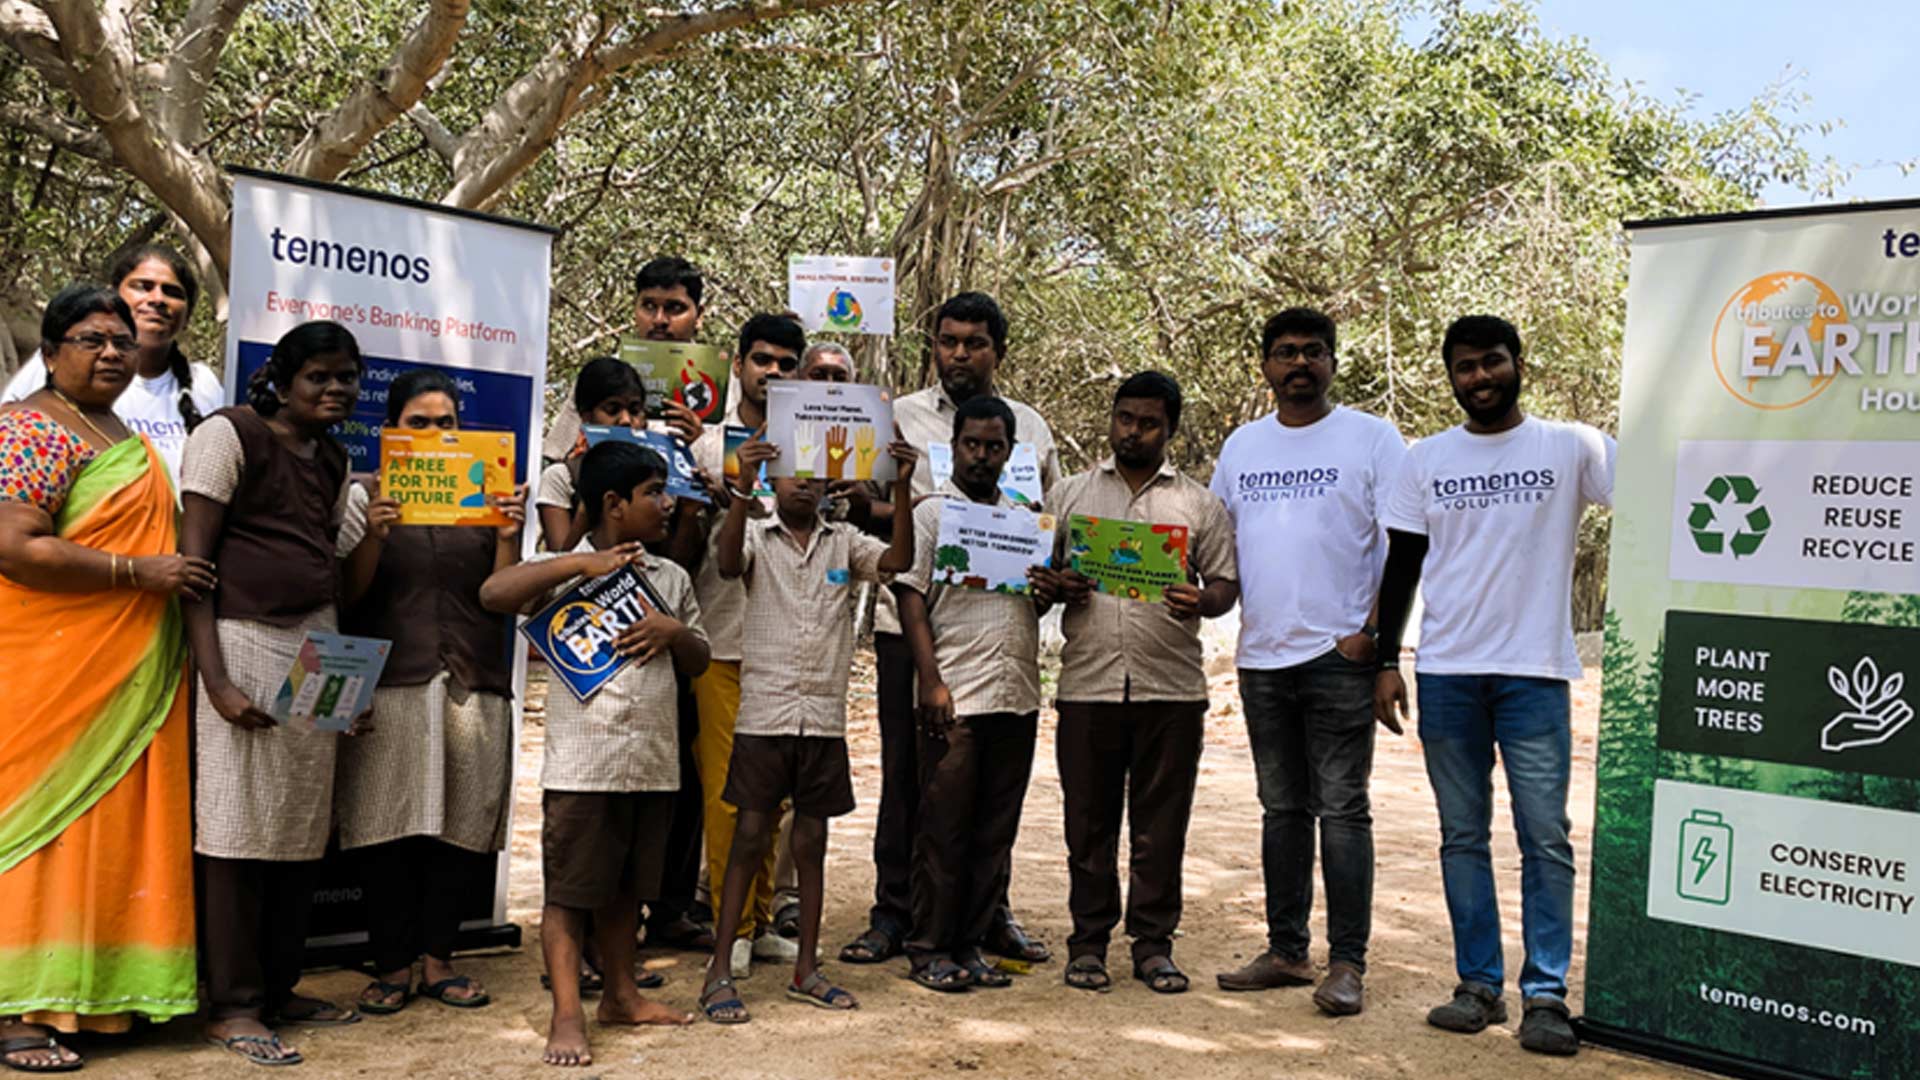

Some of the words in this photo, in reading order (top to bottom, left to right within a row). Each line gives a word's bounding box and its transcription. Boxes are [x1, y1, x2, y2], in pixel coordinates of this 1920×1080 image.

[271, 227, 430, 284] temenos
[1882, 228, 1920, 258] te
[266, 291, 365, 324] Everyone's
[370, 305, 441, 337] Banking
[445, 316, 516, 345] Platform
[1819, 302, 1840, 319] to
[804, 403, 821, 411] Love
[823, 404, 838, 412] Your
[1861, 387, 1920, 411] Hou
[389, 458, 400, 472] A
[405, 458, 446, 472] TREE
[389, 474, 422, 488] FOR
[426, 475, 458, 489] THE
[1239, 468, 1339, 490] temenos
[1433, 469, 1555, 497] temenos
[1812, 475, 1912, 497] REDUCE
[389, 490, 454, 505] FUTURE
[1443, 491, 1544, 510] VOLUNTEER
[1824, 507, 1902, 529] REUSE
[1802, 537, 1914, 562] RECYCLE
[594, 572, 636, 609] World
[1696, 646, 1770, 672] PLANT
[1697, 677, 1765, 702] MORE
[1695, 707, 1763, 733] TREES
[1770, 842, 1906, 882] CONSERVE
[1759, 872, 1915, 915] ELECTRICITY
[1700, 982, 1876, 1036] temenos.com
